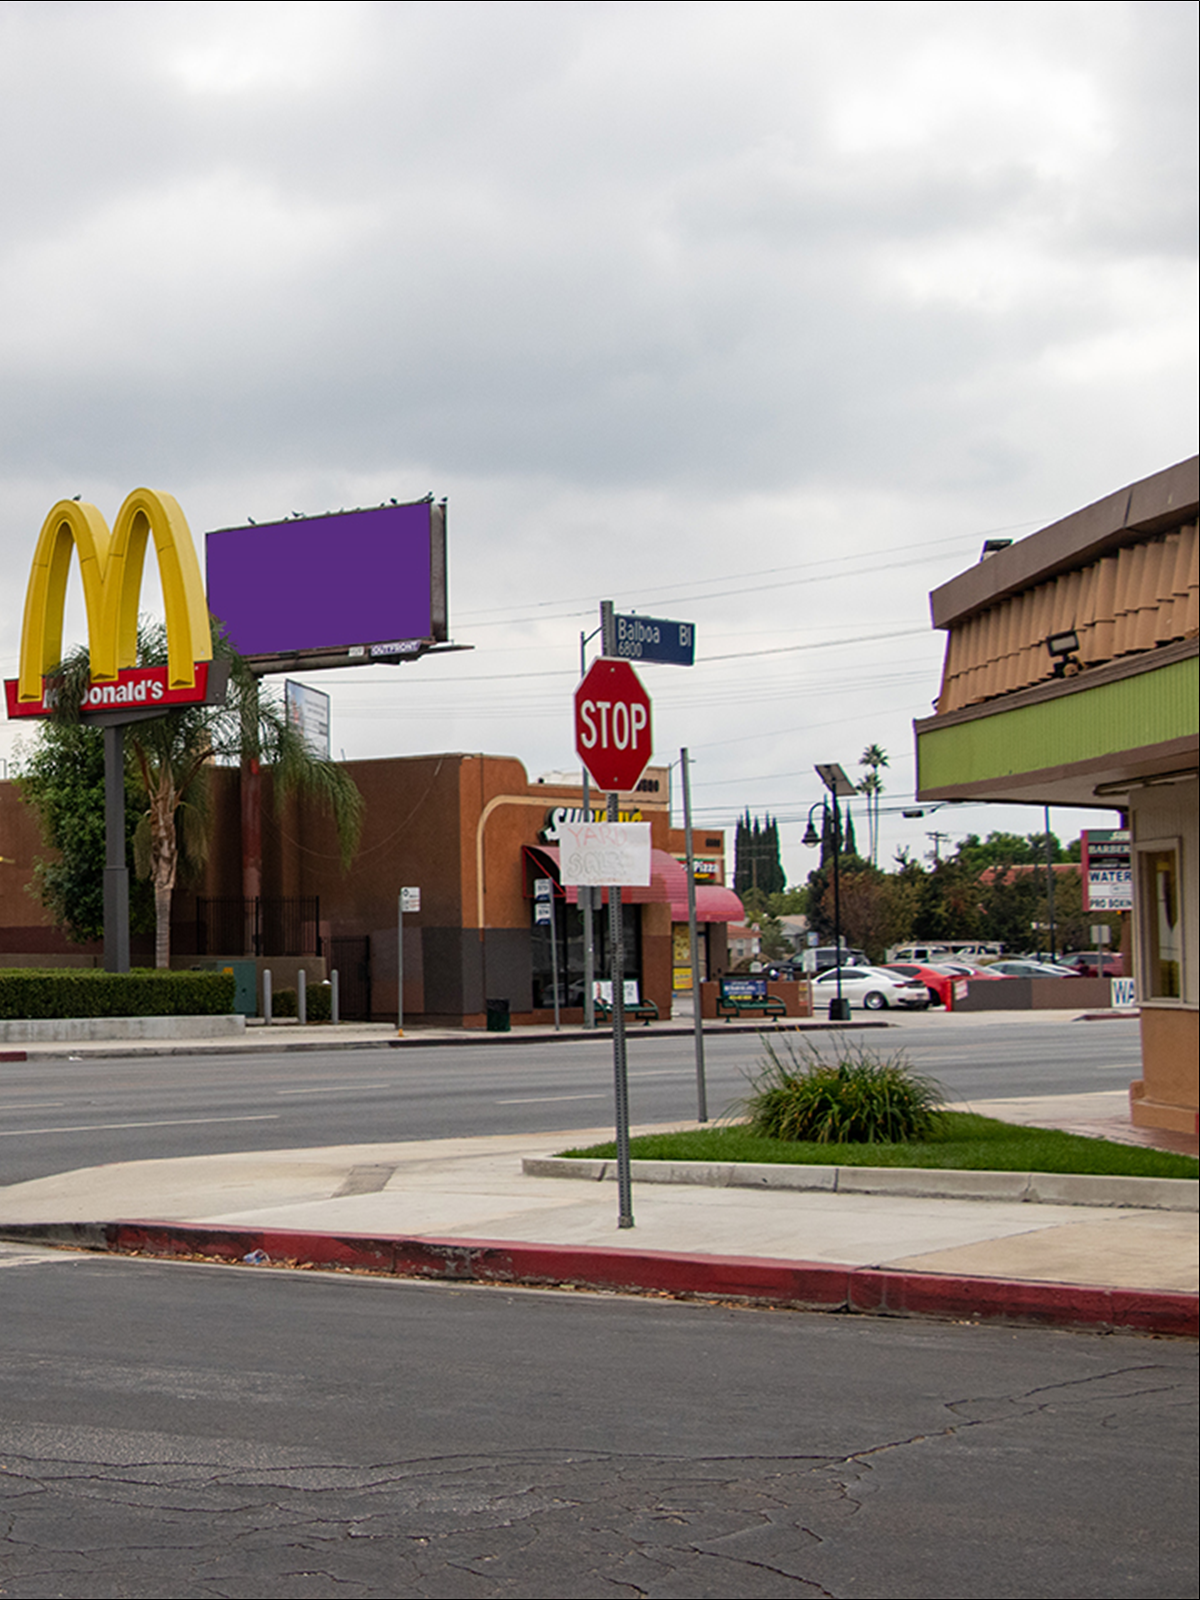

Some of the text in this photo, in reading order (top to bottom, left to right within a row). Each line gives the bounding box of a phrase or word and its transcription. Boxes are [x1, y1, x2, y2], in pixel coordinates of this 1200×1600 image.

[618, 618, 692, 647] Balboa Bl
[618, 641, 643, 657] 6800
[581, 699, 647, 750] STOP
[567, 826, 628, 847] YARD
[1089, 870, 1132, 882] WATER
